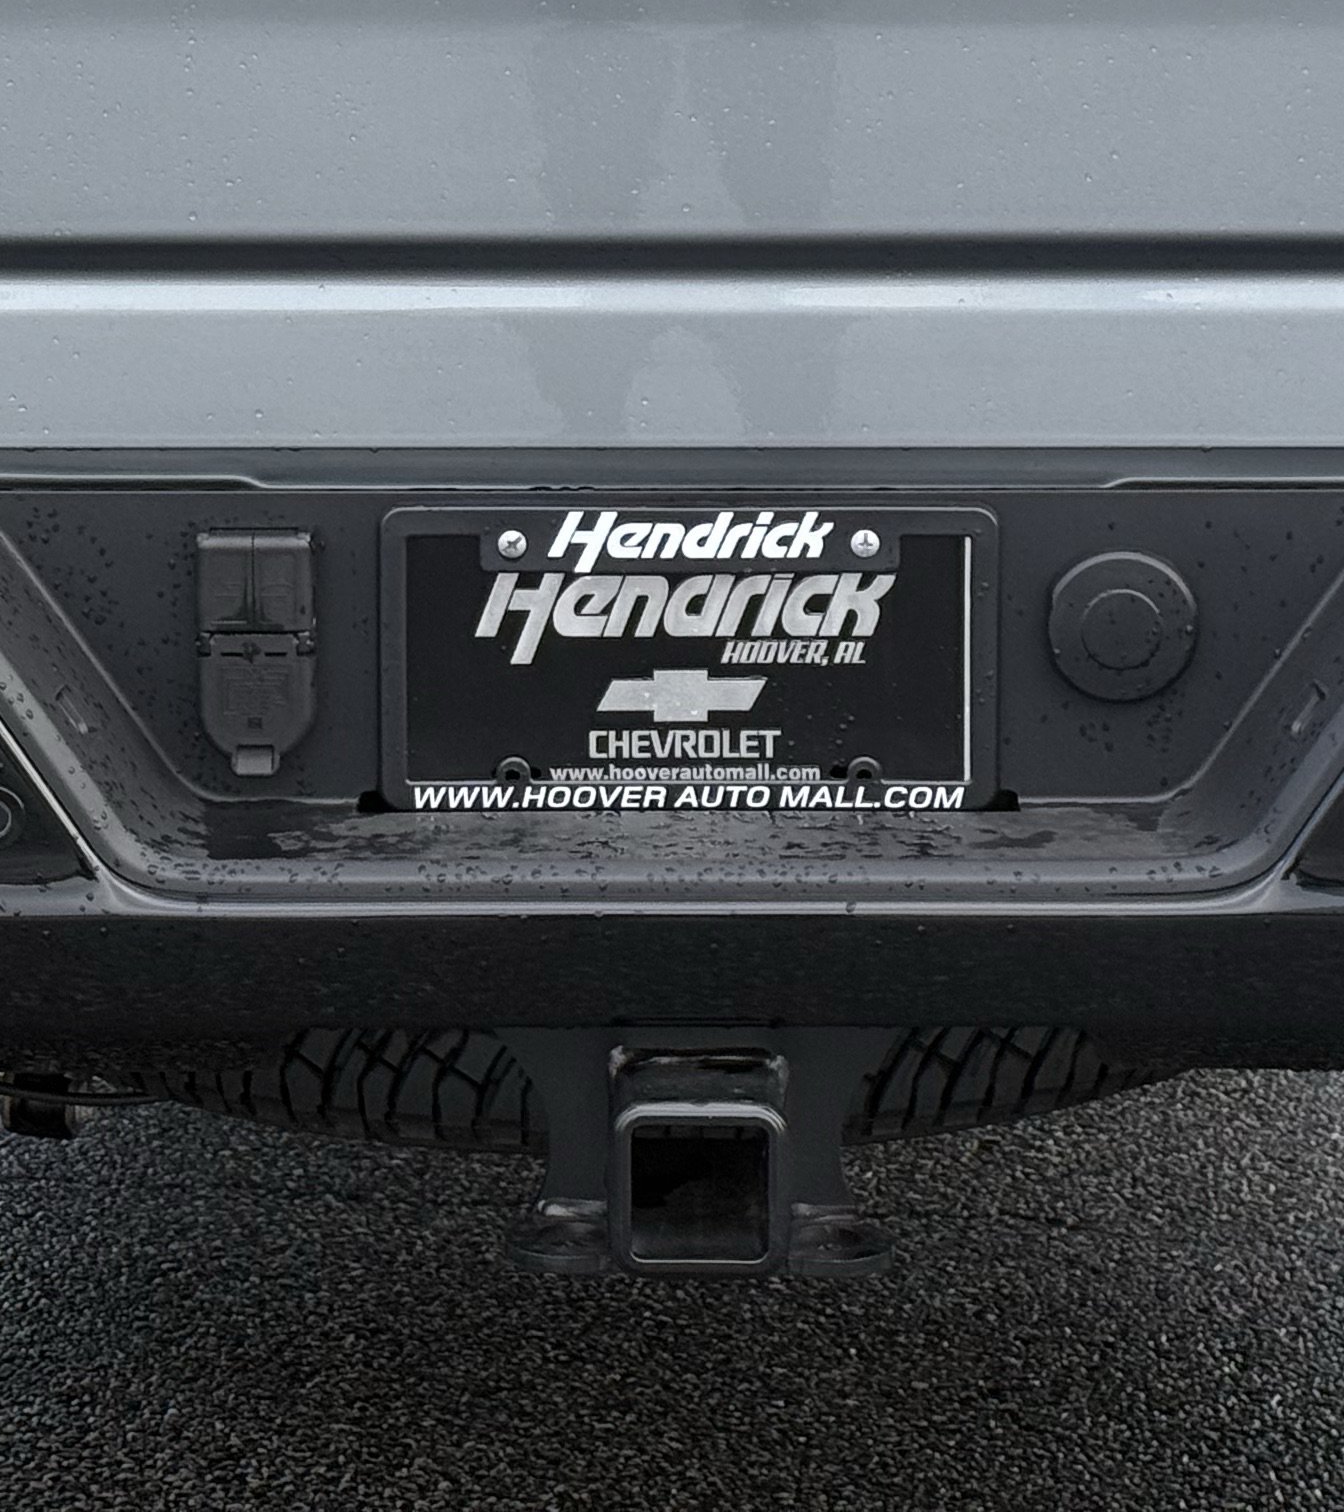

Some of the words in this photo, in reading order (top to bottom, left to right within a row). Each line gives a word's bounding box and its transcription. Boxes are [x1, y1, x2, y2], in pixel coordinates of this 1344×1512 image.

[547, 511, 834, 573] Hendrick
[474, 572, 897, 666] Hendrick
[720, 639, 829, 667] HOOVER,
[833, 640, 867, 665] AL
[588, 730, 782, 760] CHEVROLET
[549, 764, 821, 783] www.hooverautomall.com
[413, 785, 669, 811] WWW.HOOVER
[678, 785, 773, 810] AUTO
[779, 785, 965, 810] MALL.COM
